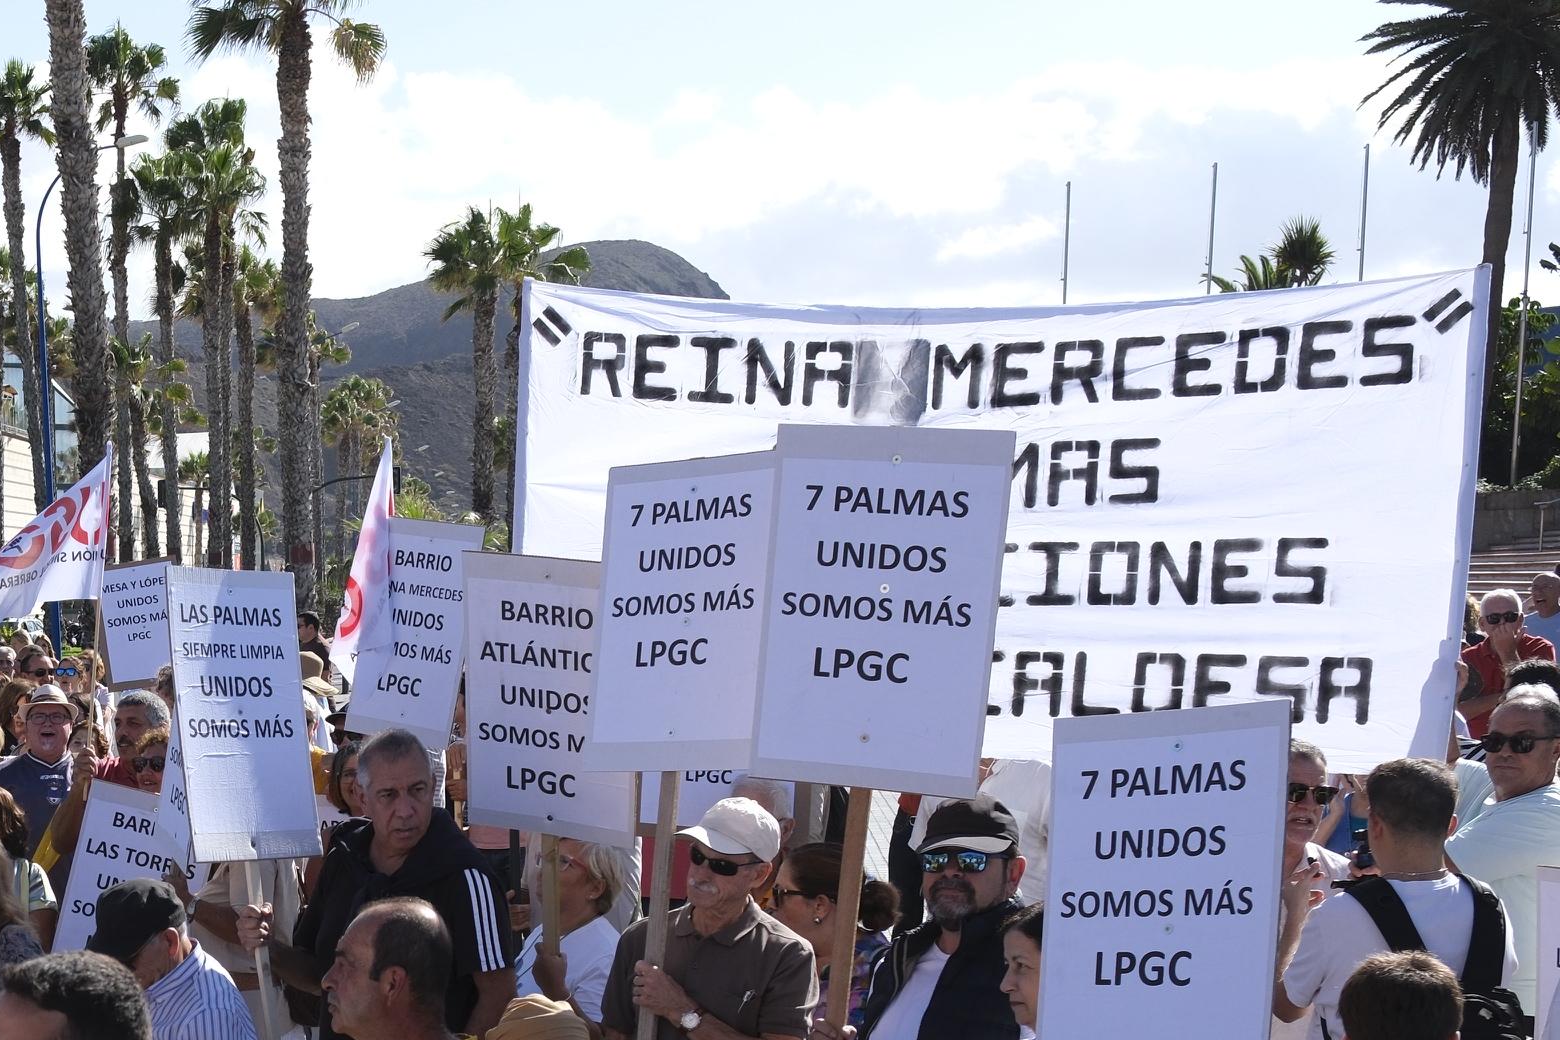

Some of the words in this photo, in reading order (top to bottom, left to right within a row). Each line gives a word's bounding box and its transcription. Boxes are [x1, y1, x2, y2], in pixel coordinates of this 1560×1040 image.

[630, 504, 645, 527] 7
[651, 493, 752, 526] PALMAS
[805, 484, 824, 511] 7
[834, 485, 969, 519] PALMAS
[394, 549, 453, 572] BARRIO
[639, 542, 736, 573] UNIDOS
[817, 540, 947, 574] UNIDOS
[131, 580, 137, 589] Y
[140, 576, 166, 588] LÓPE
[408, 583, 464, 602] MERCEDES
[117, 595, 159, 609] UNIDOS
[180, 602, 209, 624] LAS
[214, 604, 282, 628] PALMAS
[501, 600, 594, 630] BARRIO
[611, 592, 696, 618] SOMOS
[703, 583, 755, 612] MÁS
[781, 591, 893, 622] SOMOS
[902, 595, 972, 628] MÁS
[108, 616, 146, 628] SOMOS
[127, 631, 152, 642] LPGC
[182, 642, 237, 659] SIEMPRE
[239, 644, 285, 660] LIMPIA
[420, 644, 452, 665] MÁS
[635, 637, 709, 668] LPGC
[813, 646, 910, 684] LPGC
[200, 675, 273, 698] UNIDOS
[377, 673, 422, 698] LPGC
[188, 718, 251, 739] SOMOS
[254, 713, 294, 738] MÁS
[478, 722, 560, 750] SOMOS
[506, 765, 576, 798] LPGC
[1081, 770, 1099, 800] 7
[1110, 759, 1246, 799] PALMAS
[1095, 825, 1226, 860] UNIDOS
[85, 837, 120, 860] LAS
[125, 847, 195, 879] TORRS
[1060, 889, 1174, 919] SOMOS
[1183, 879, 1253, 916] MÁS
[1094, 950, 1192, 987] LPGC
